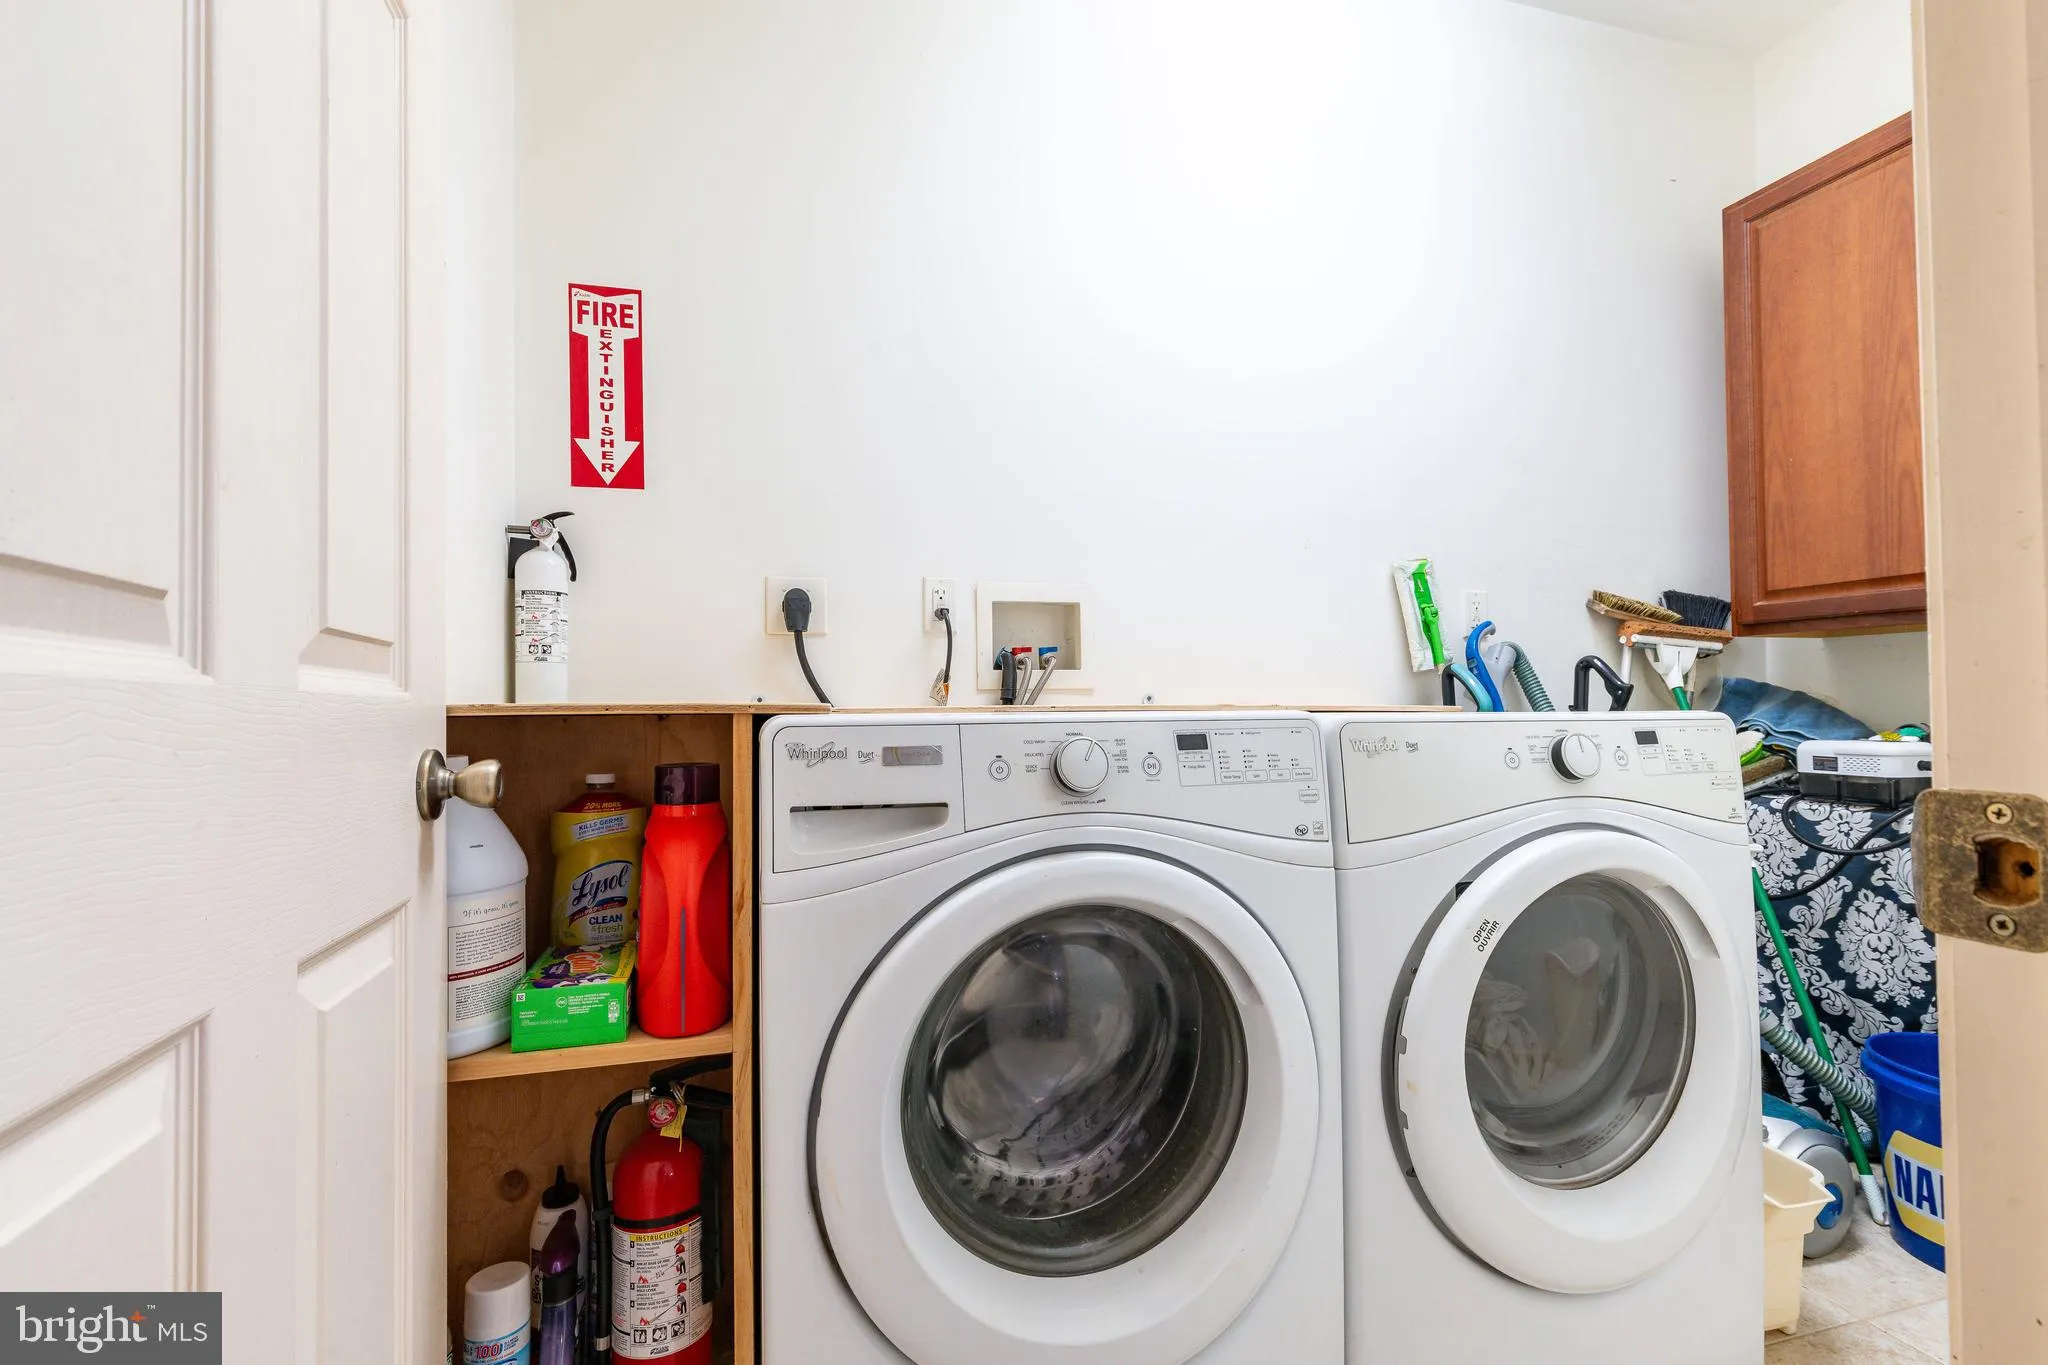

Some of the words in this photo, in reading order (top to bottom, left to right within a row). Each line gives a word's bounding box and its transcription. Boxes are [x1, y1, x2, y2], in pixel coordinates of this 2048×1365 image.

[577, 299, 634, 329] FIRE
[599, 328, 615, 473] EXTINGUISHER
[787, 746, 848, 761] Whirlpool
[857, 750, 874, 759] Duet
[578, 821, 598, 831] KILLS
[599, 816, 624, 826] GERMS
[572, 864, 629, 907] Lysol
[588, 914, 623, 925] CLEAN
[597, 923, 624, 934] fresh
[1472, 918, 1490, 943] OPEN
[1477, 920, 1500, 952] OUVRIR
[635, 1228, 683, 1242] INSTRUCTIONS
[474, 1342, 500, 1359] 100
